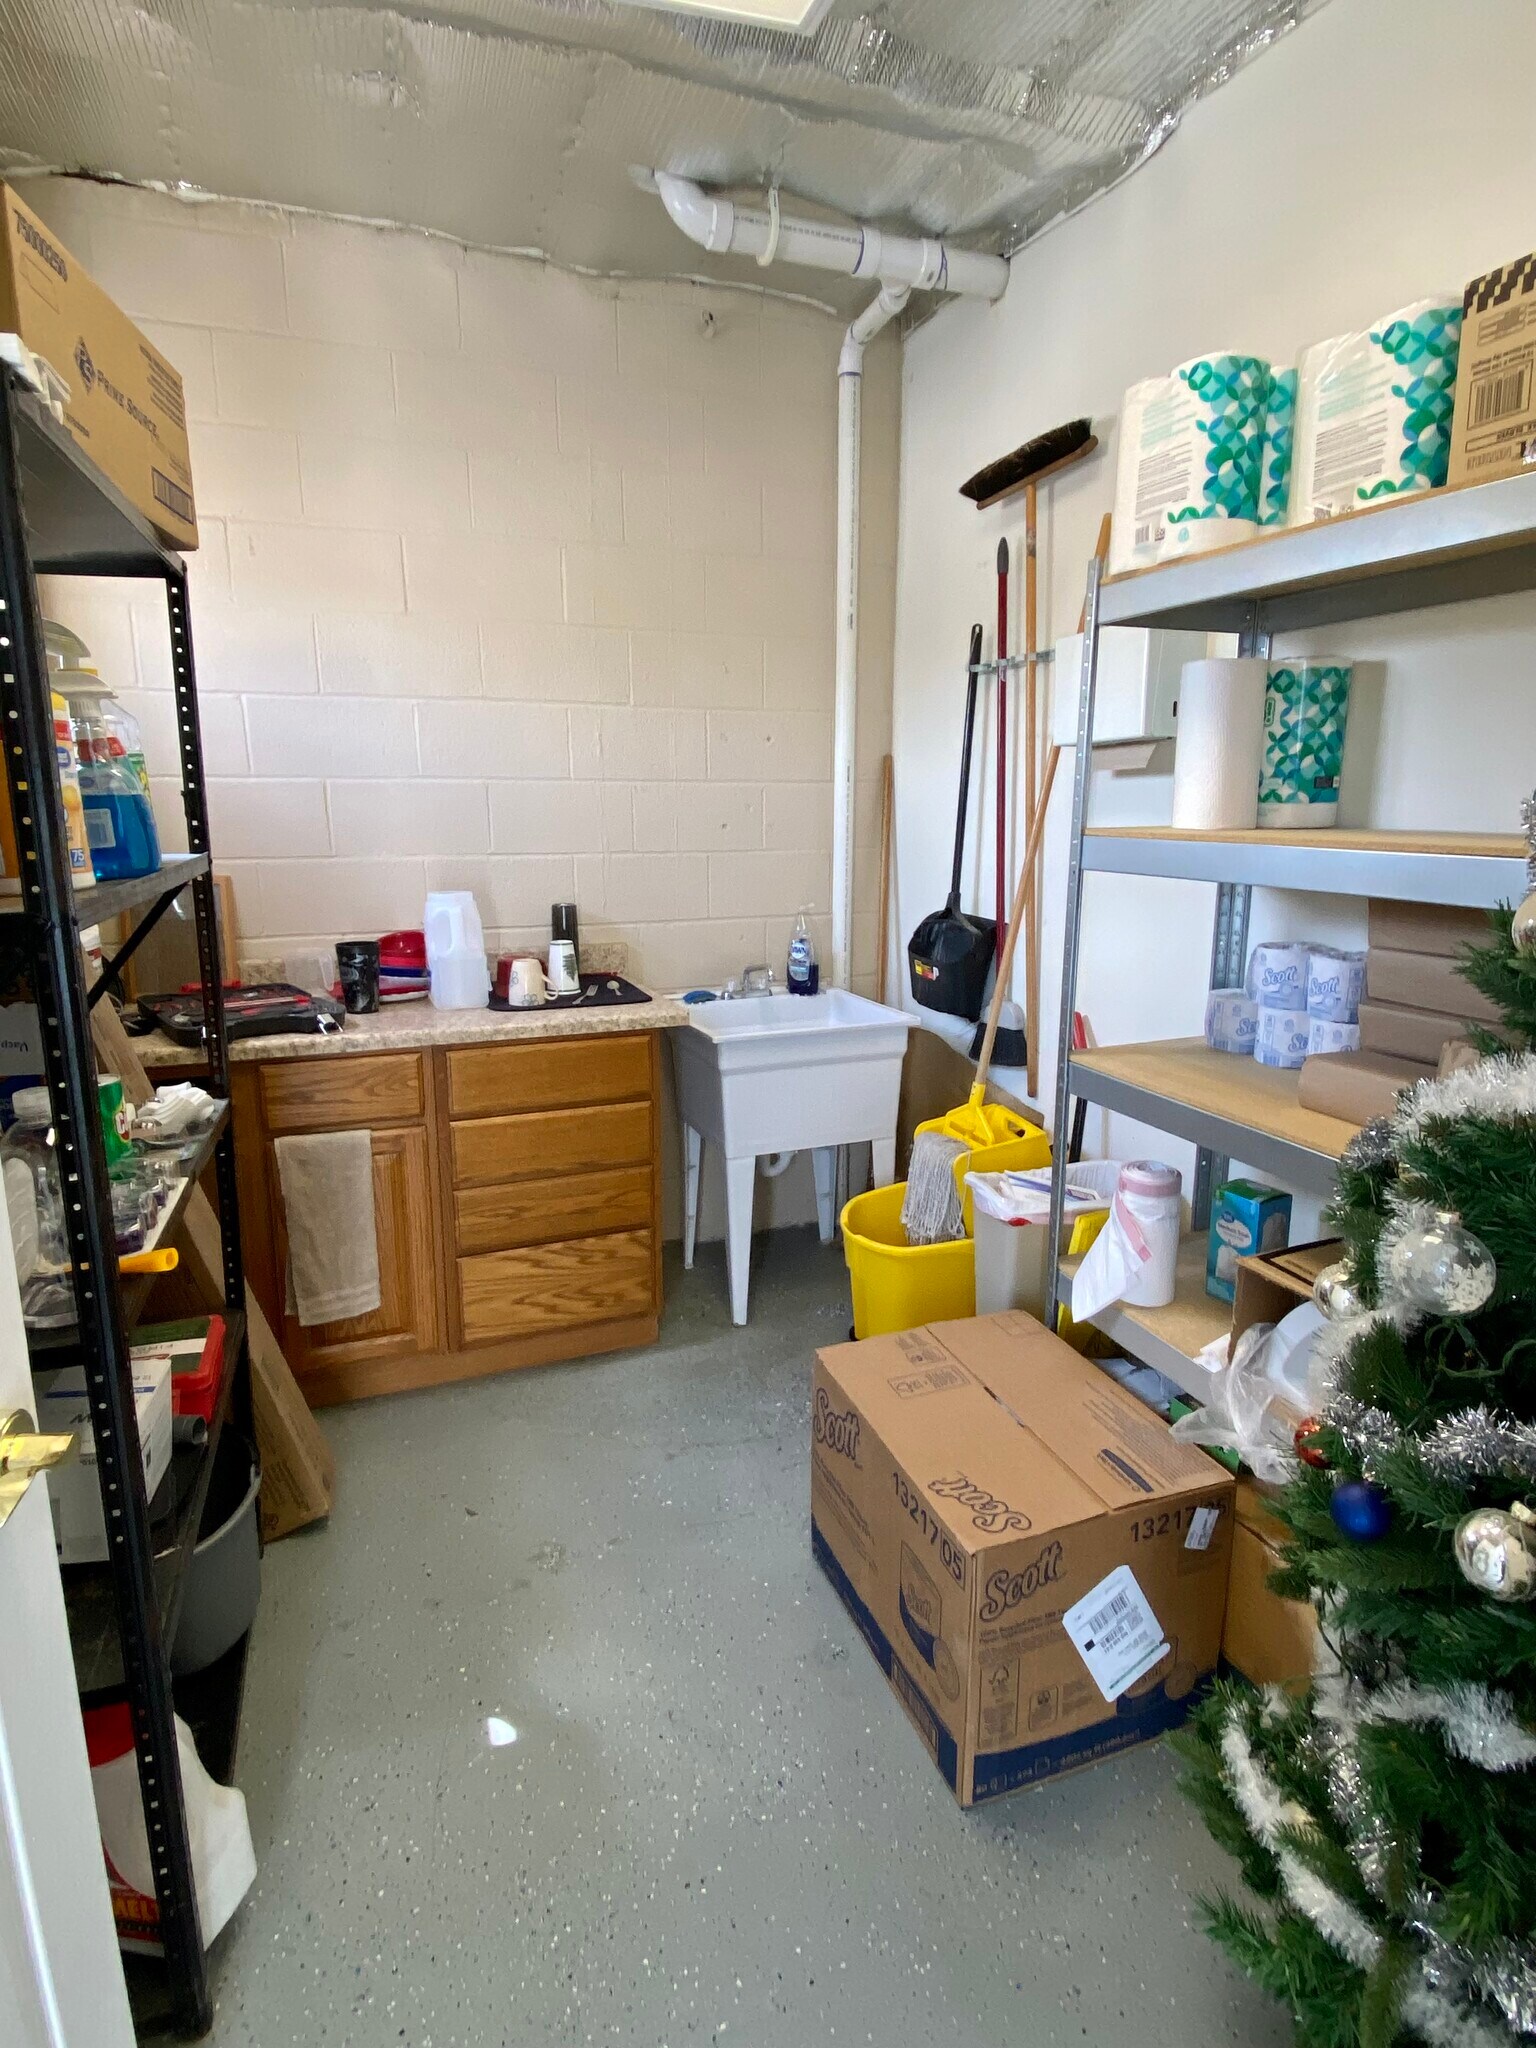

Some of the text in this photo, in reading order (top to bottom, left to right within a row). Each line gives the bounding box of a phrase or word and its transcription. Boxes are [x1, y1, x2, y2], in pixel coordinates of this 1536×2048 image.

[72, 849, 85, 863] 75
[1262, 966, 1298, 986] Scott
[1309, 976, 1341, 996] Scott
[813, 1387, 861, 1460] Scott
[893, 1472, 963, 1581] 13217 05
[927, 1477, 1032, 1534] Scott
[979, 1540, 1063, 1622] Scott
